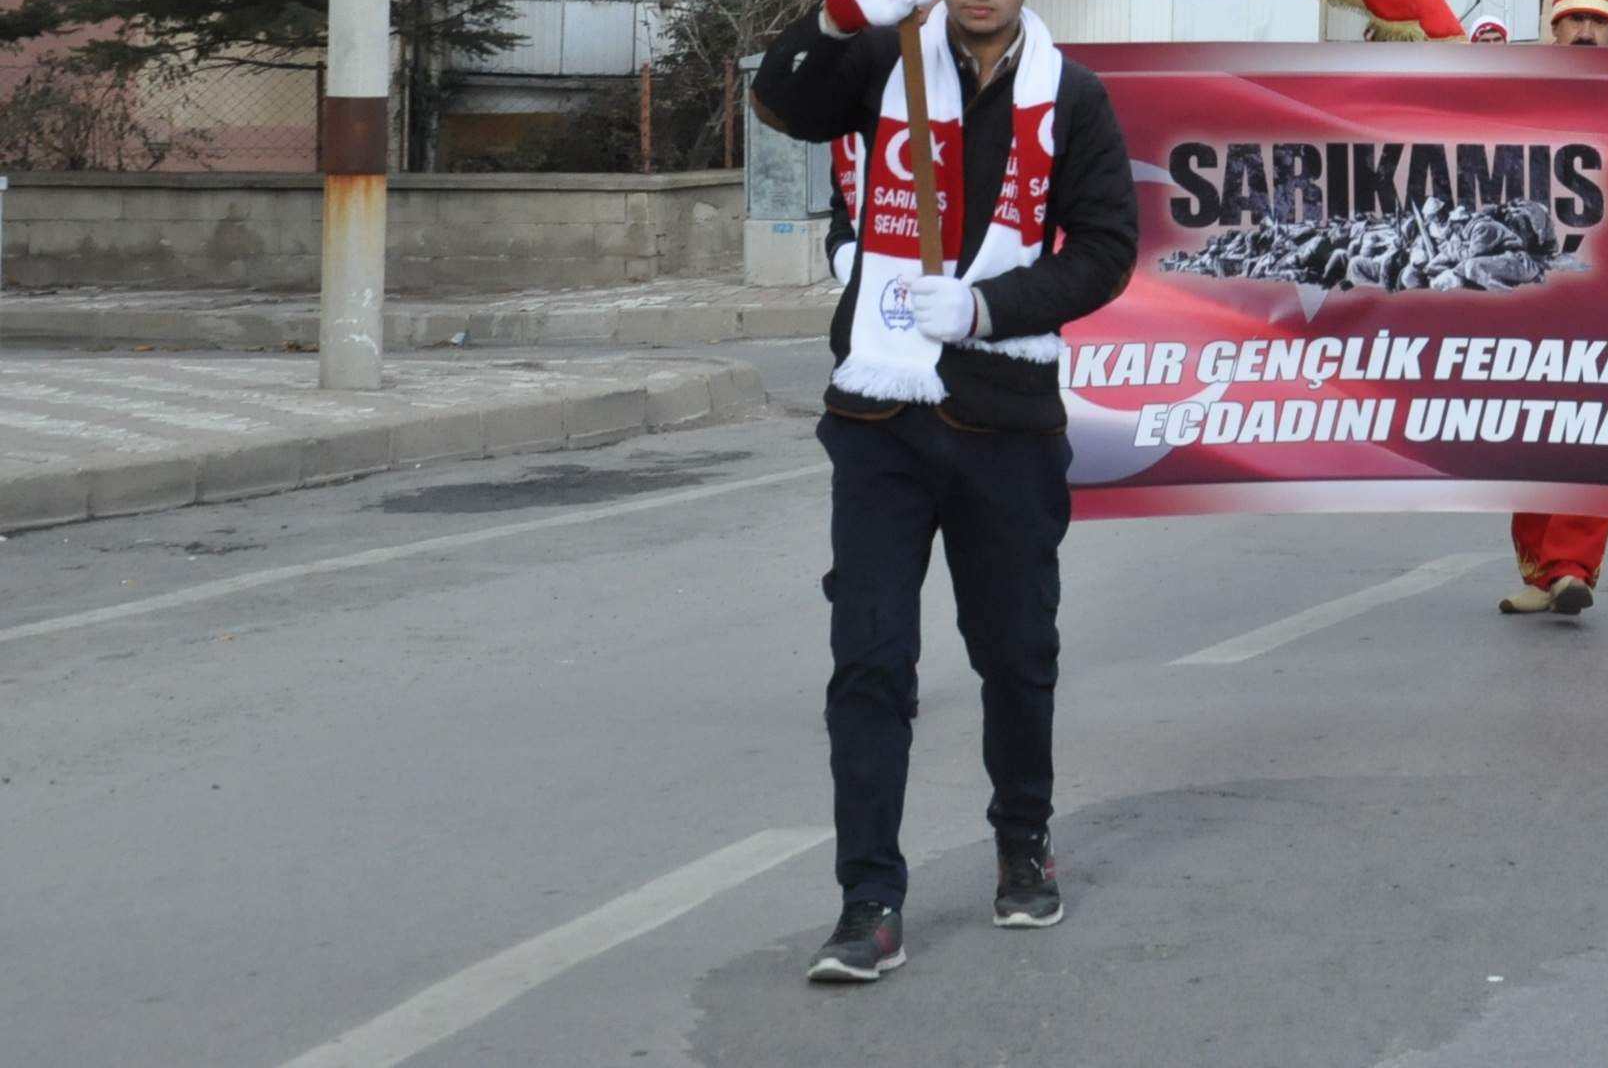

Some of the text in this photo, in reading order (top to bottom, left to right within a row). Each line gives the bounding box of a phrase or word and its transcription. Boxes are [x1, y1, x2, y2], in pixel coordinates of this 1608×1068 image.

[1168, 141, 1606, 254] SARIKAMIŞ
[1196, 329, 1430, 389] GENÇLİK
[1133, 397, 1397, 448] ECDADINI
